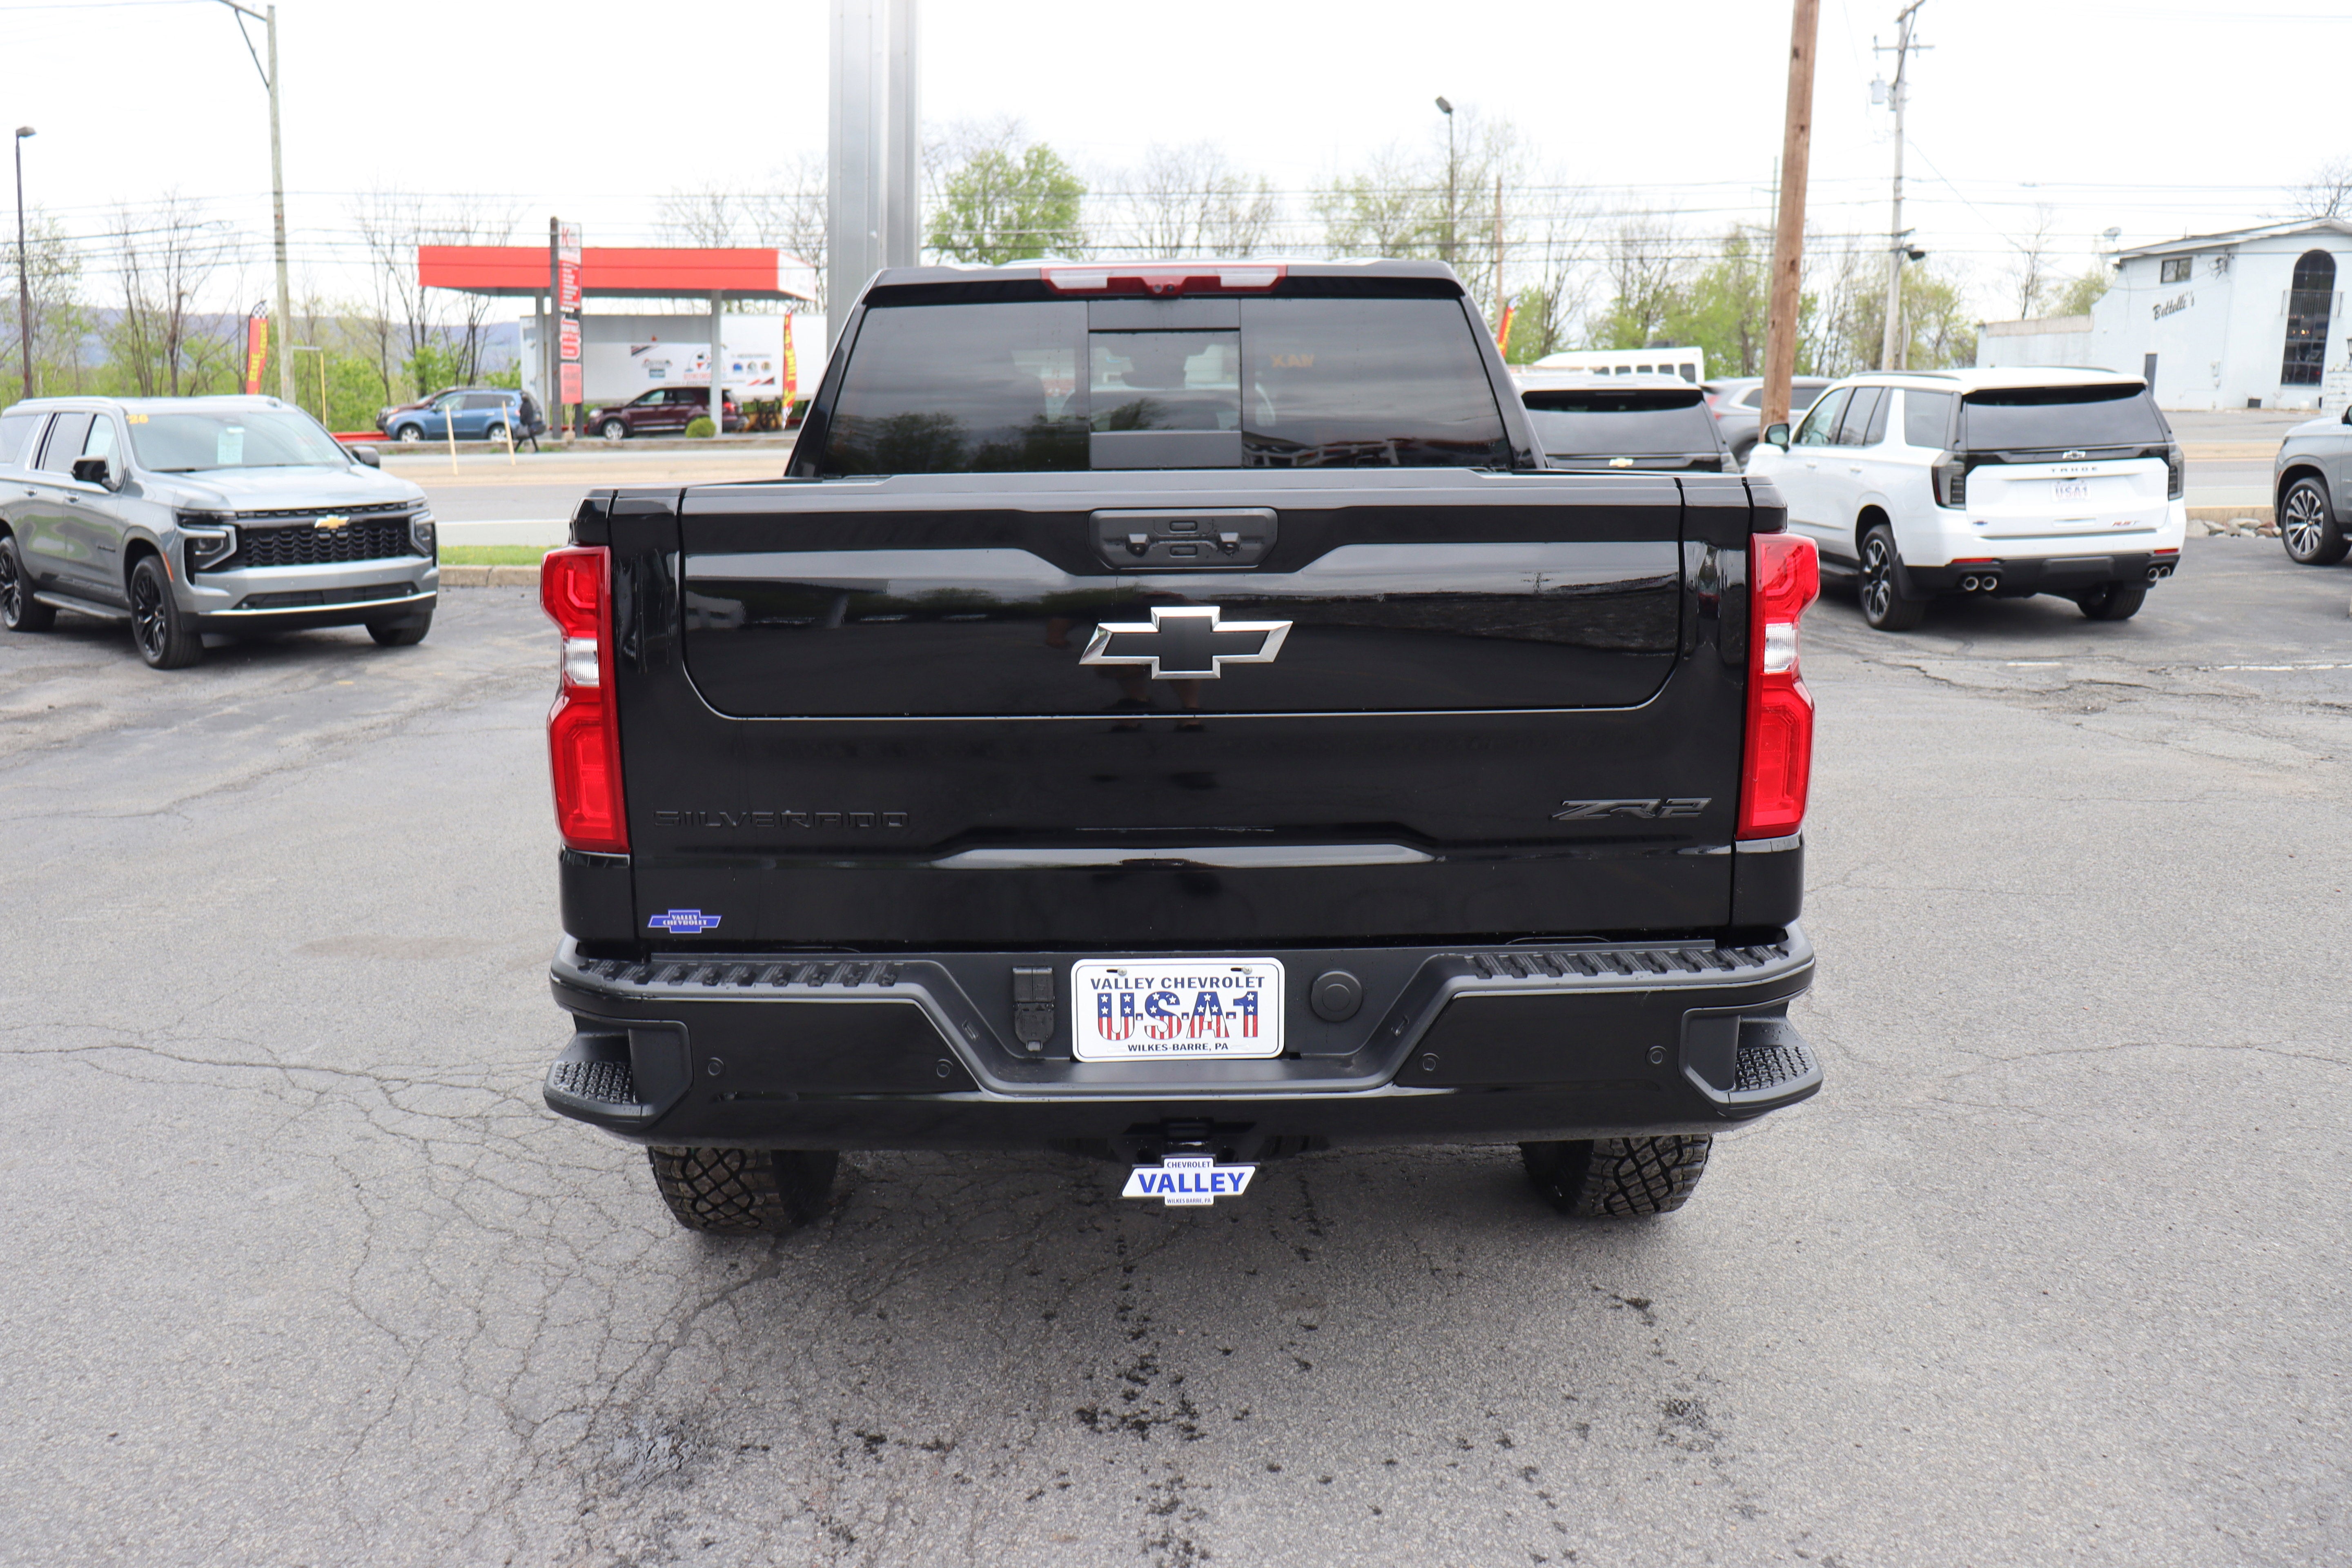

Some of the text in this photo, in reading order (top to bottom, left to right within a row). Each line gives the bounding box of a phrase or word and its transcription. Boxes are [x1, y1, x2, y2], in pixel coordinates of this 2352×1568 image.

[1548, 798, 1712, 820] ZR2
[654, 810, 910, 828] SILVERADO
[1091, 976, 1265, 990] VALLEY CHEVROLET
[1128, 1042, 1229, 1052] WILKES-BARRE, PA
[1138, 1172, 1245, 1194] VALLEY
